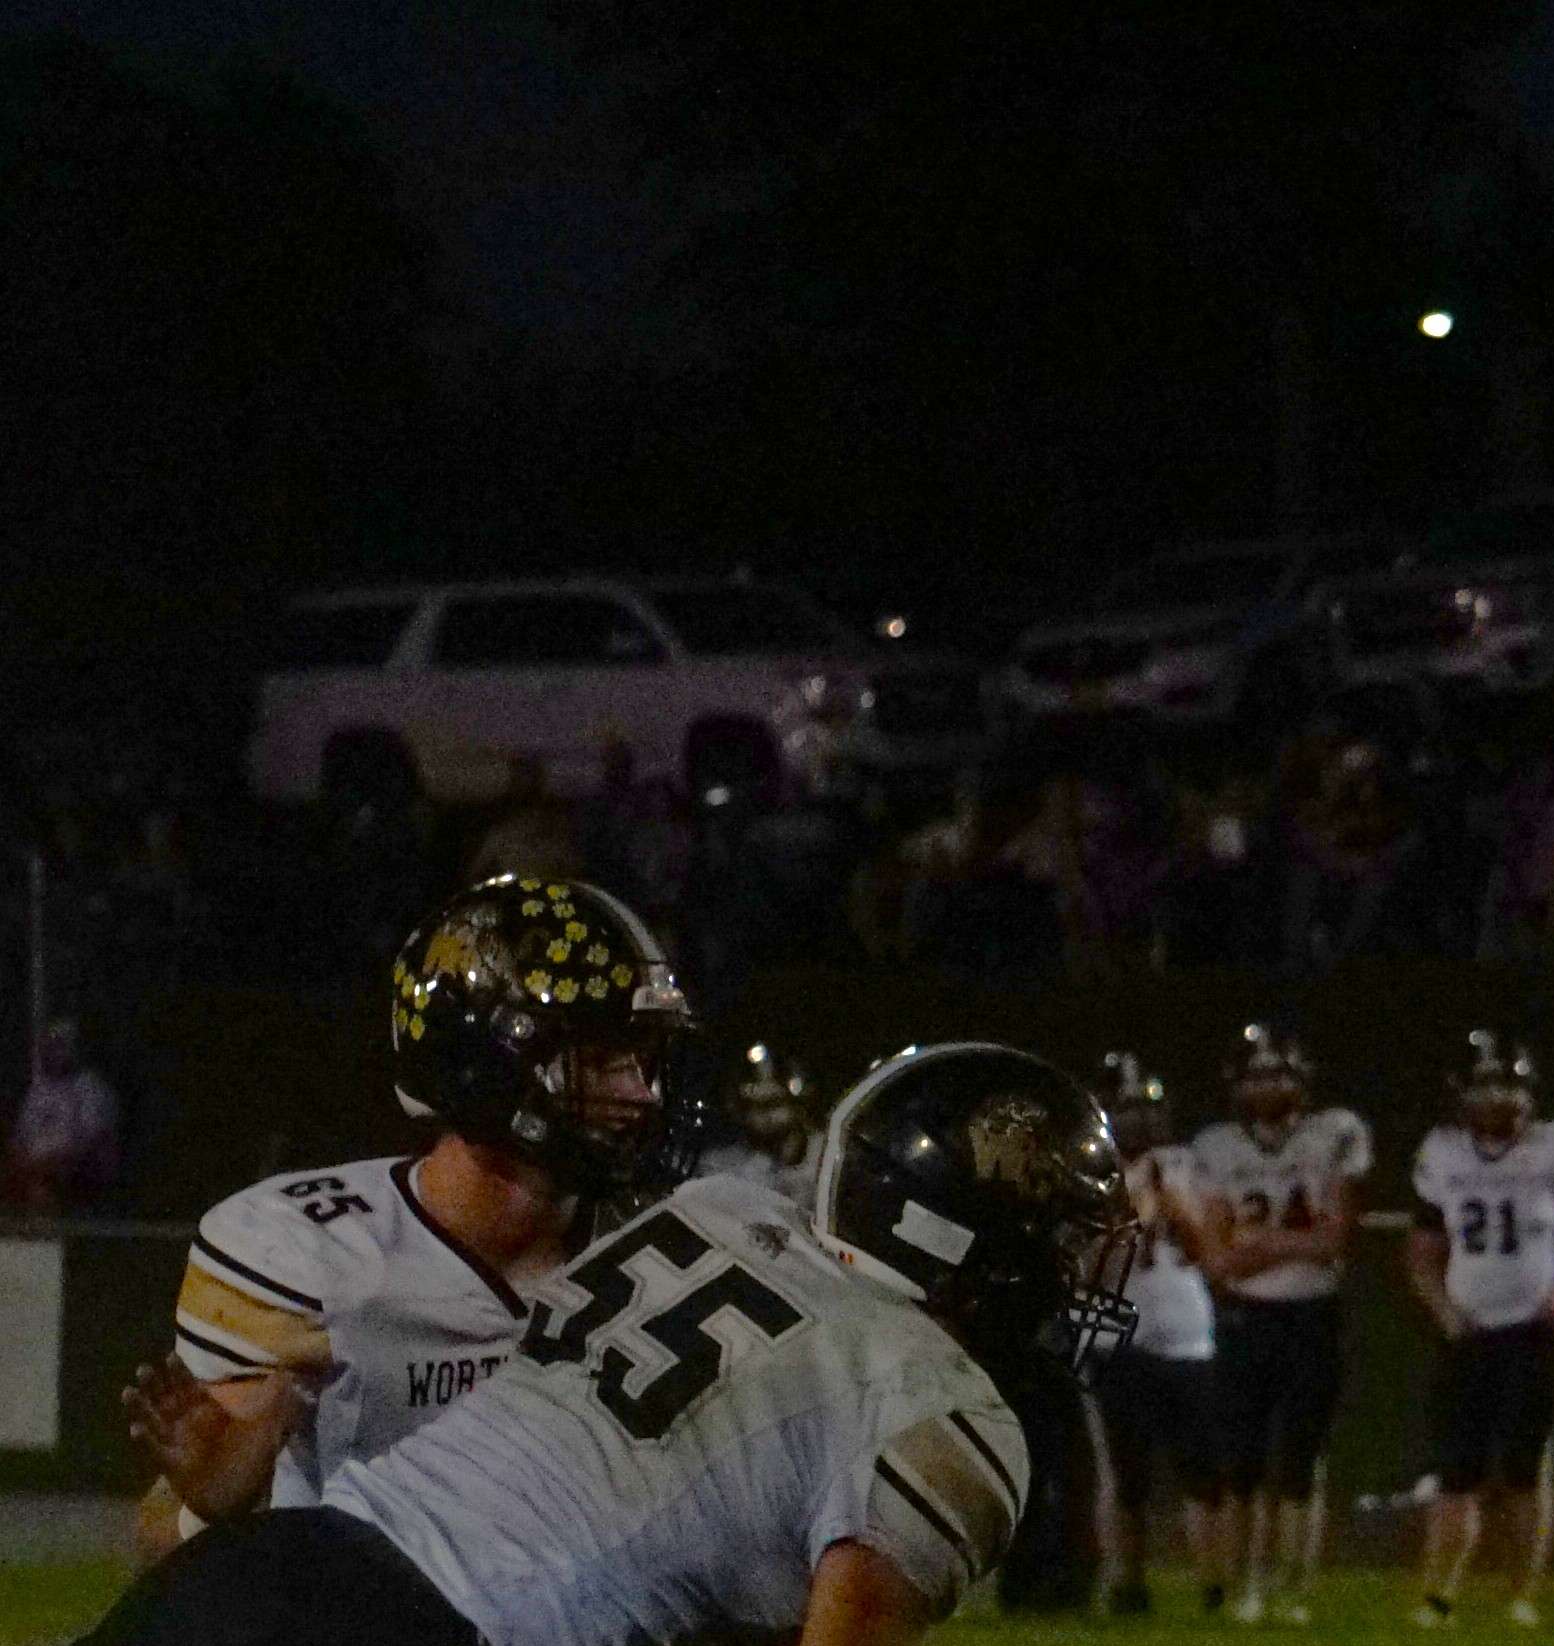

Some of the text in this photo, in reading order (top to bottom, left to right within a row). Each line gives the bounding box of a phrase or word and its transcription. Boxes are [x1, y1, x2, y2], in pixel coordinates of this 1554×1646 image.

[281, 1176, 374, 1224] 65
[1462, 1198, 1519, 1255] 21
[520, 1207, 808, 1441] 55
[406, 1355, 508, 1408] WORT
